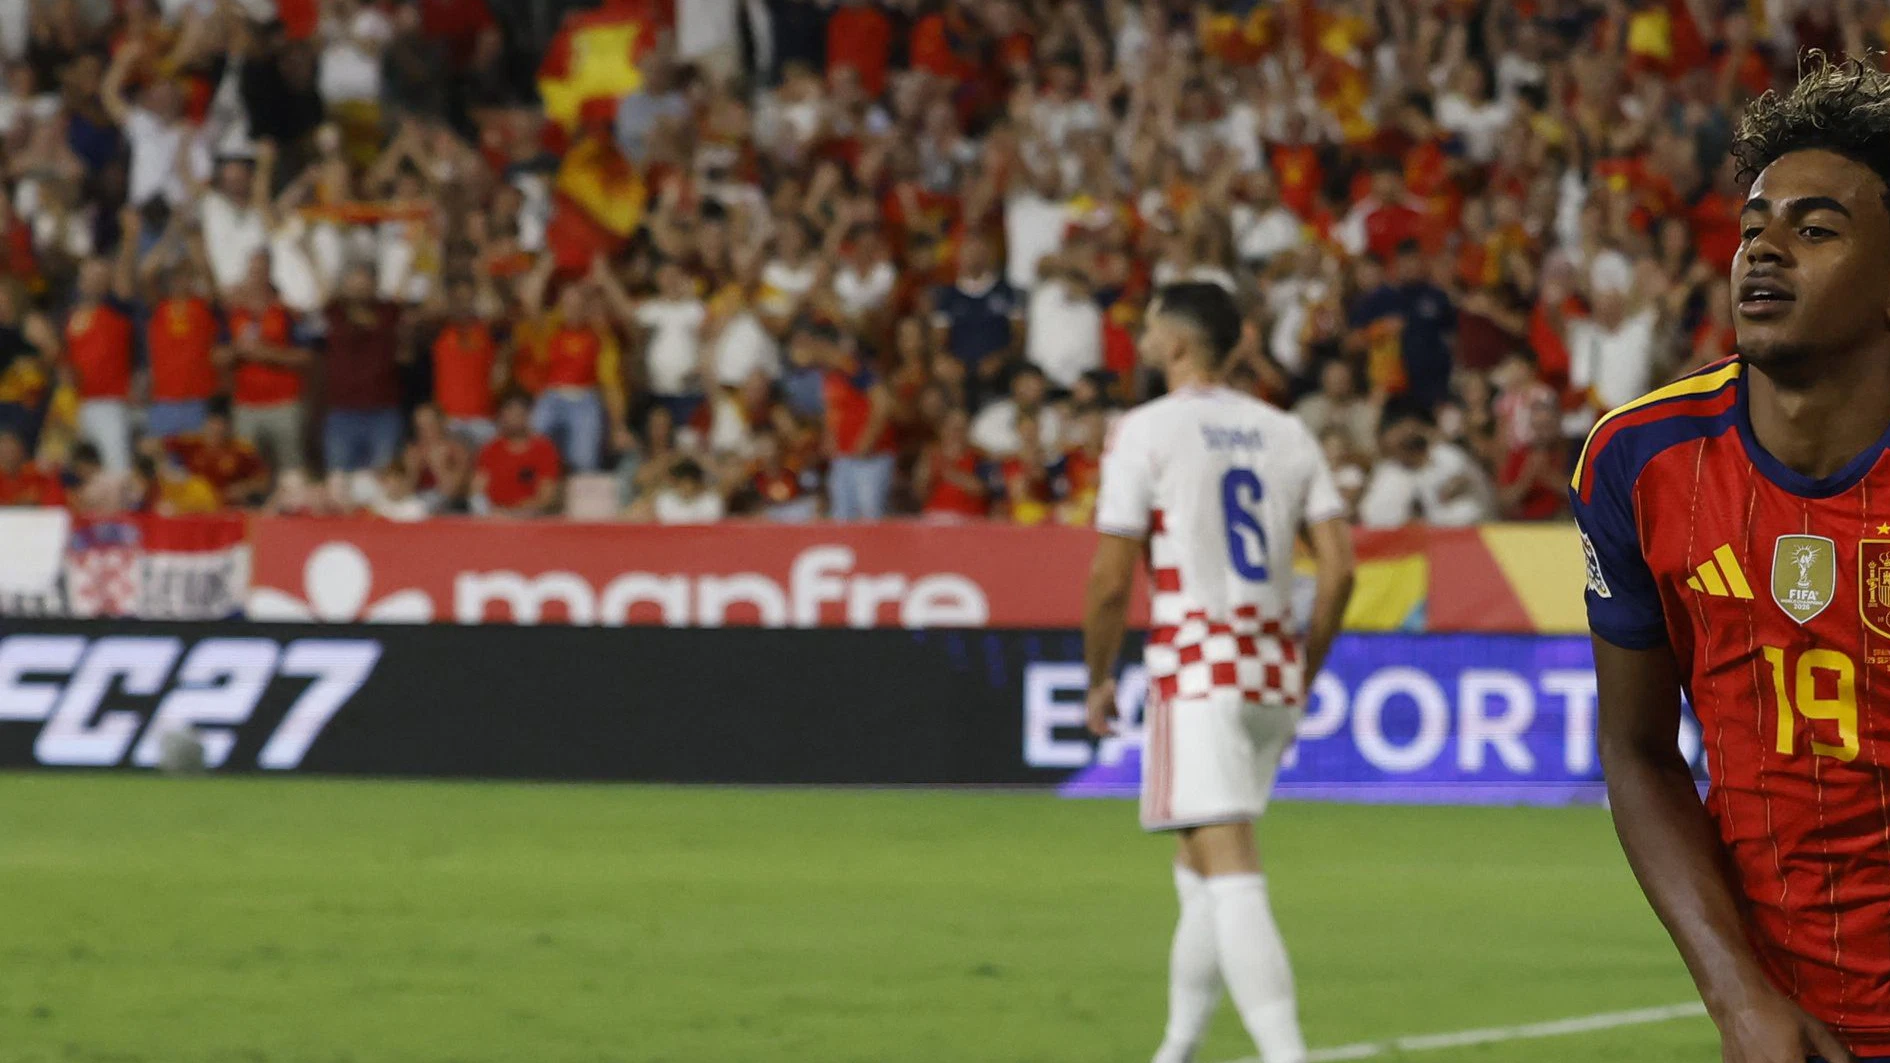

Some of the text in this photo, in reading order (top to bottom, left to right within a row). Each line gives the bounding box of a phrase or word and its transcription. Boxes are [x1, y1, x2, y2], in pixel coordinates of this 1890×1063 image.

[1222, 468, 1269, 583] 6
[1789, 589, 1816, 600] FIFA
[1762, 645, 1860, 763] 19
